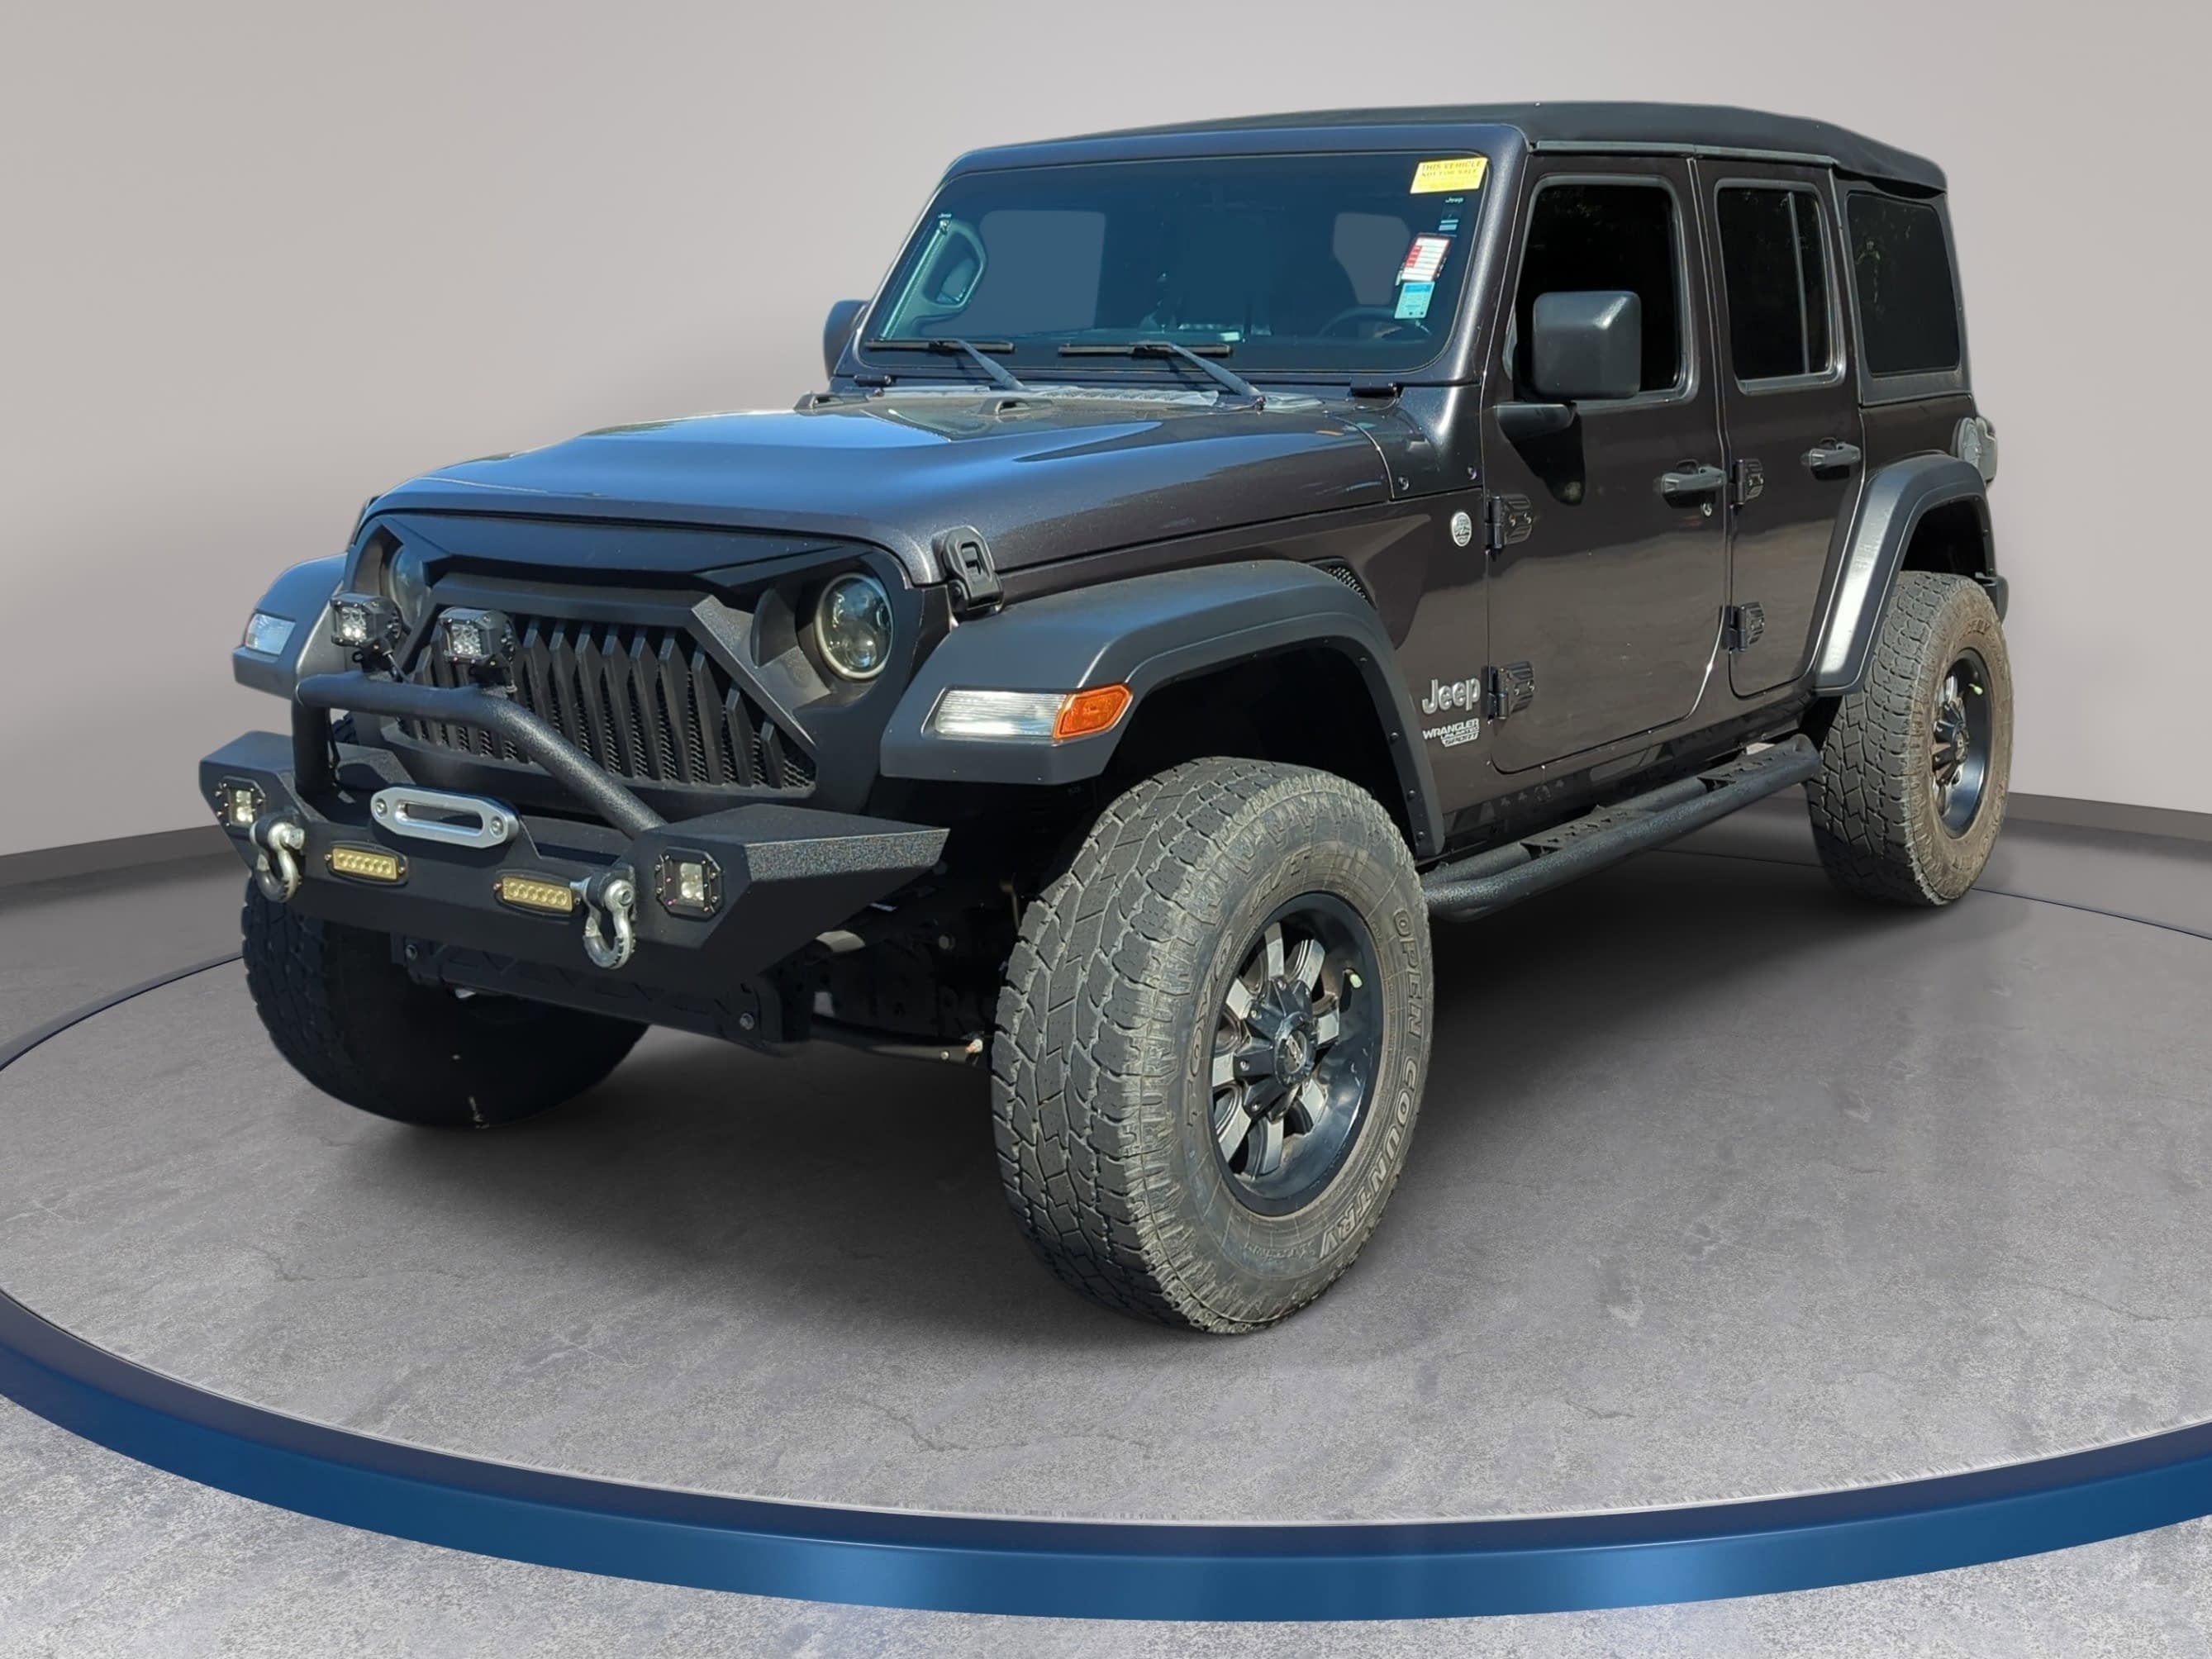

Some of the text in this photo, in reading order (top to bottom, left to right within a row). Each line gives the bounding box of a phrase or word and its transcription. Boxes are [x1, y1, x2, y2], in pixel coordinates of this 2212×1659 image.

[1422, 678, 1481, 714] Jeep
[1422, 718, 1479, 739] WRANGLER
[1320, 909, 1424, 1258] OPEN COUNTRY
